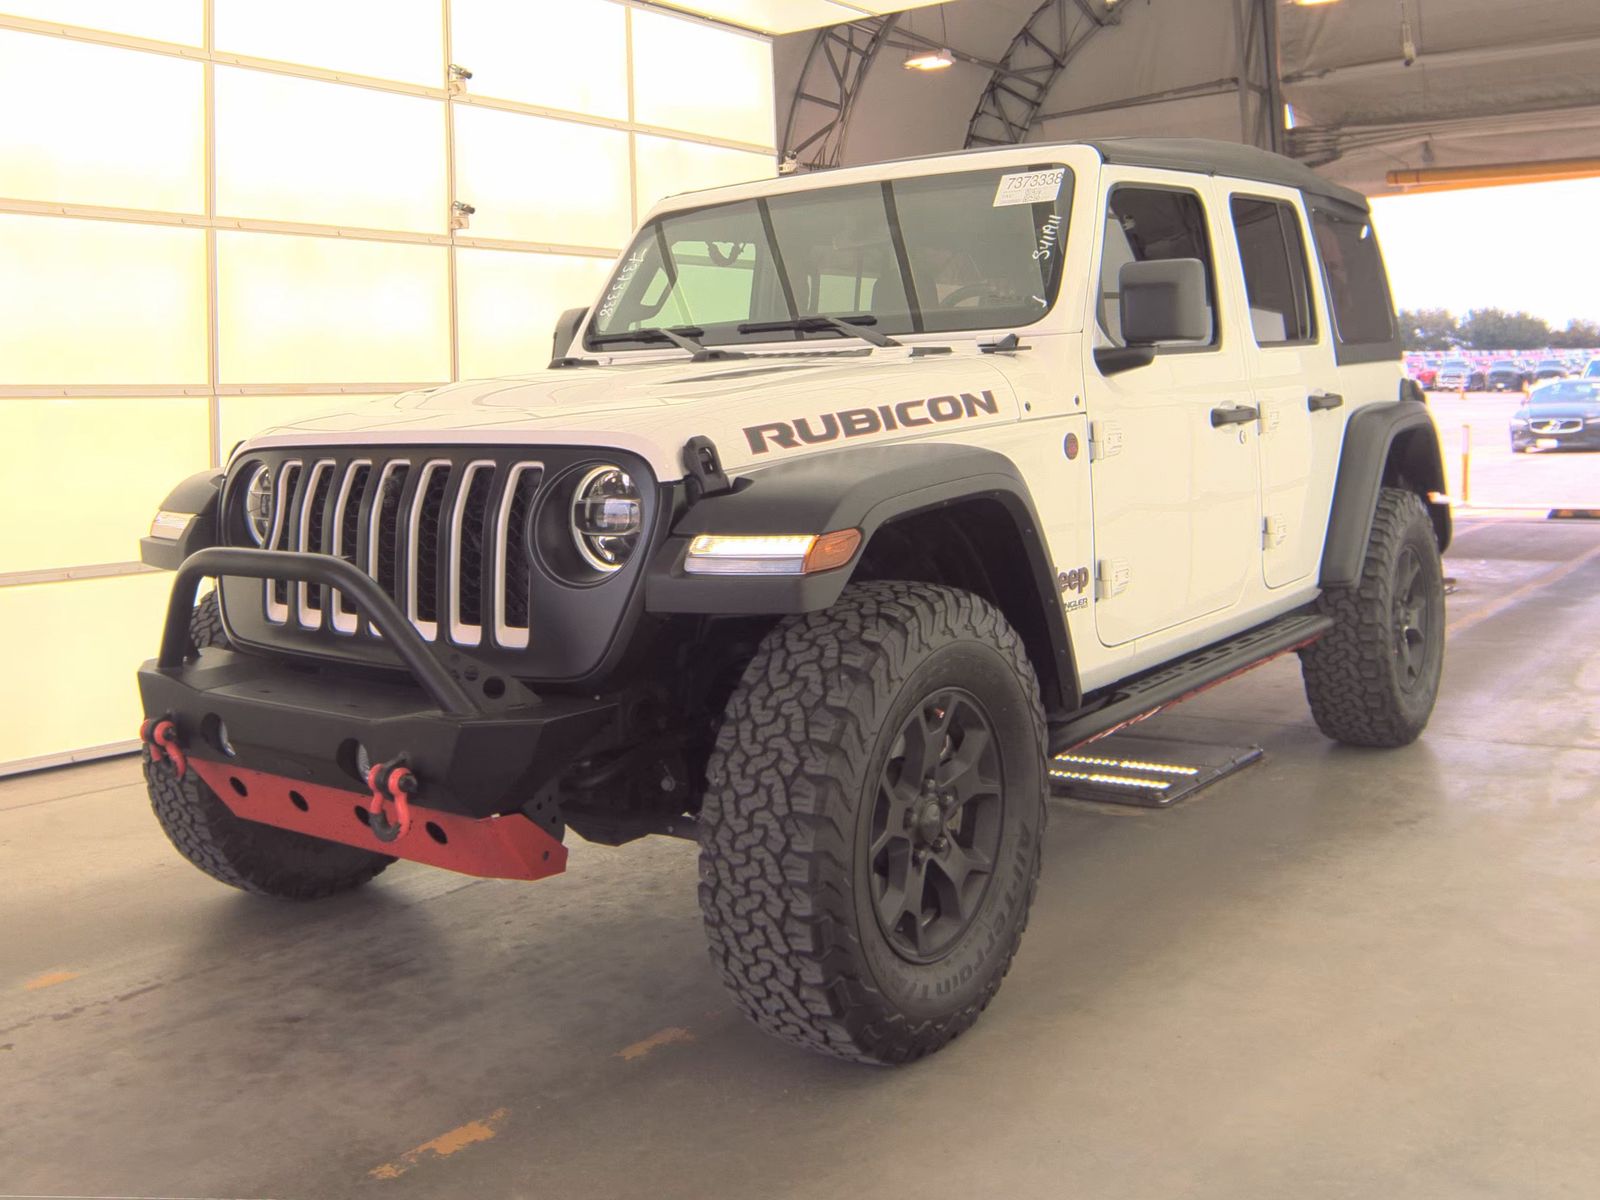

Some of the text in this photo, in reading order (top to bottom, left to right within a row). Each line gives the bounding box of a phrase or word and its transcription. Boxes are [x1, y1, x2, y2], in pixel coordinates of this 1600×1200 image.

[1007, 172, 1063, 190] 7373338
[742, 390, 999, 455] RUBICON
[1055, 566, 1089, 593] eep
